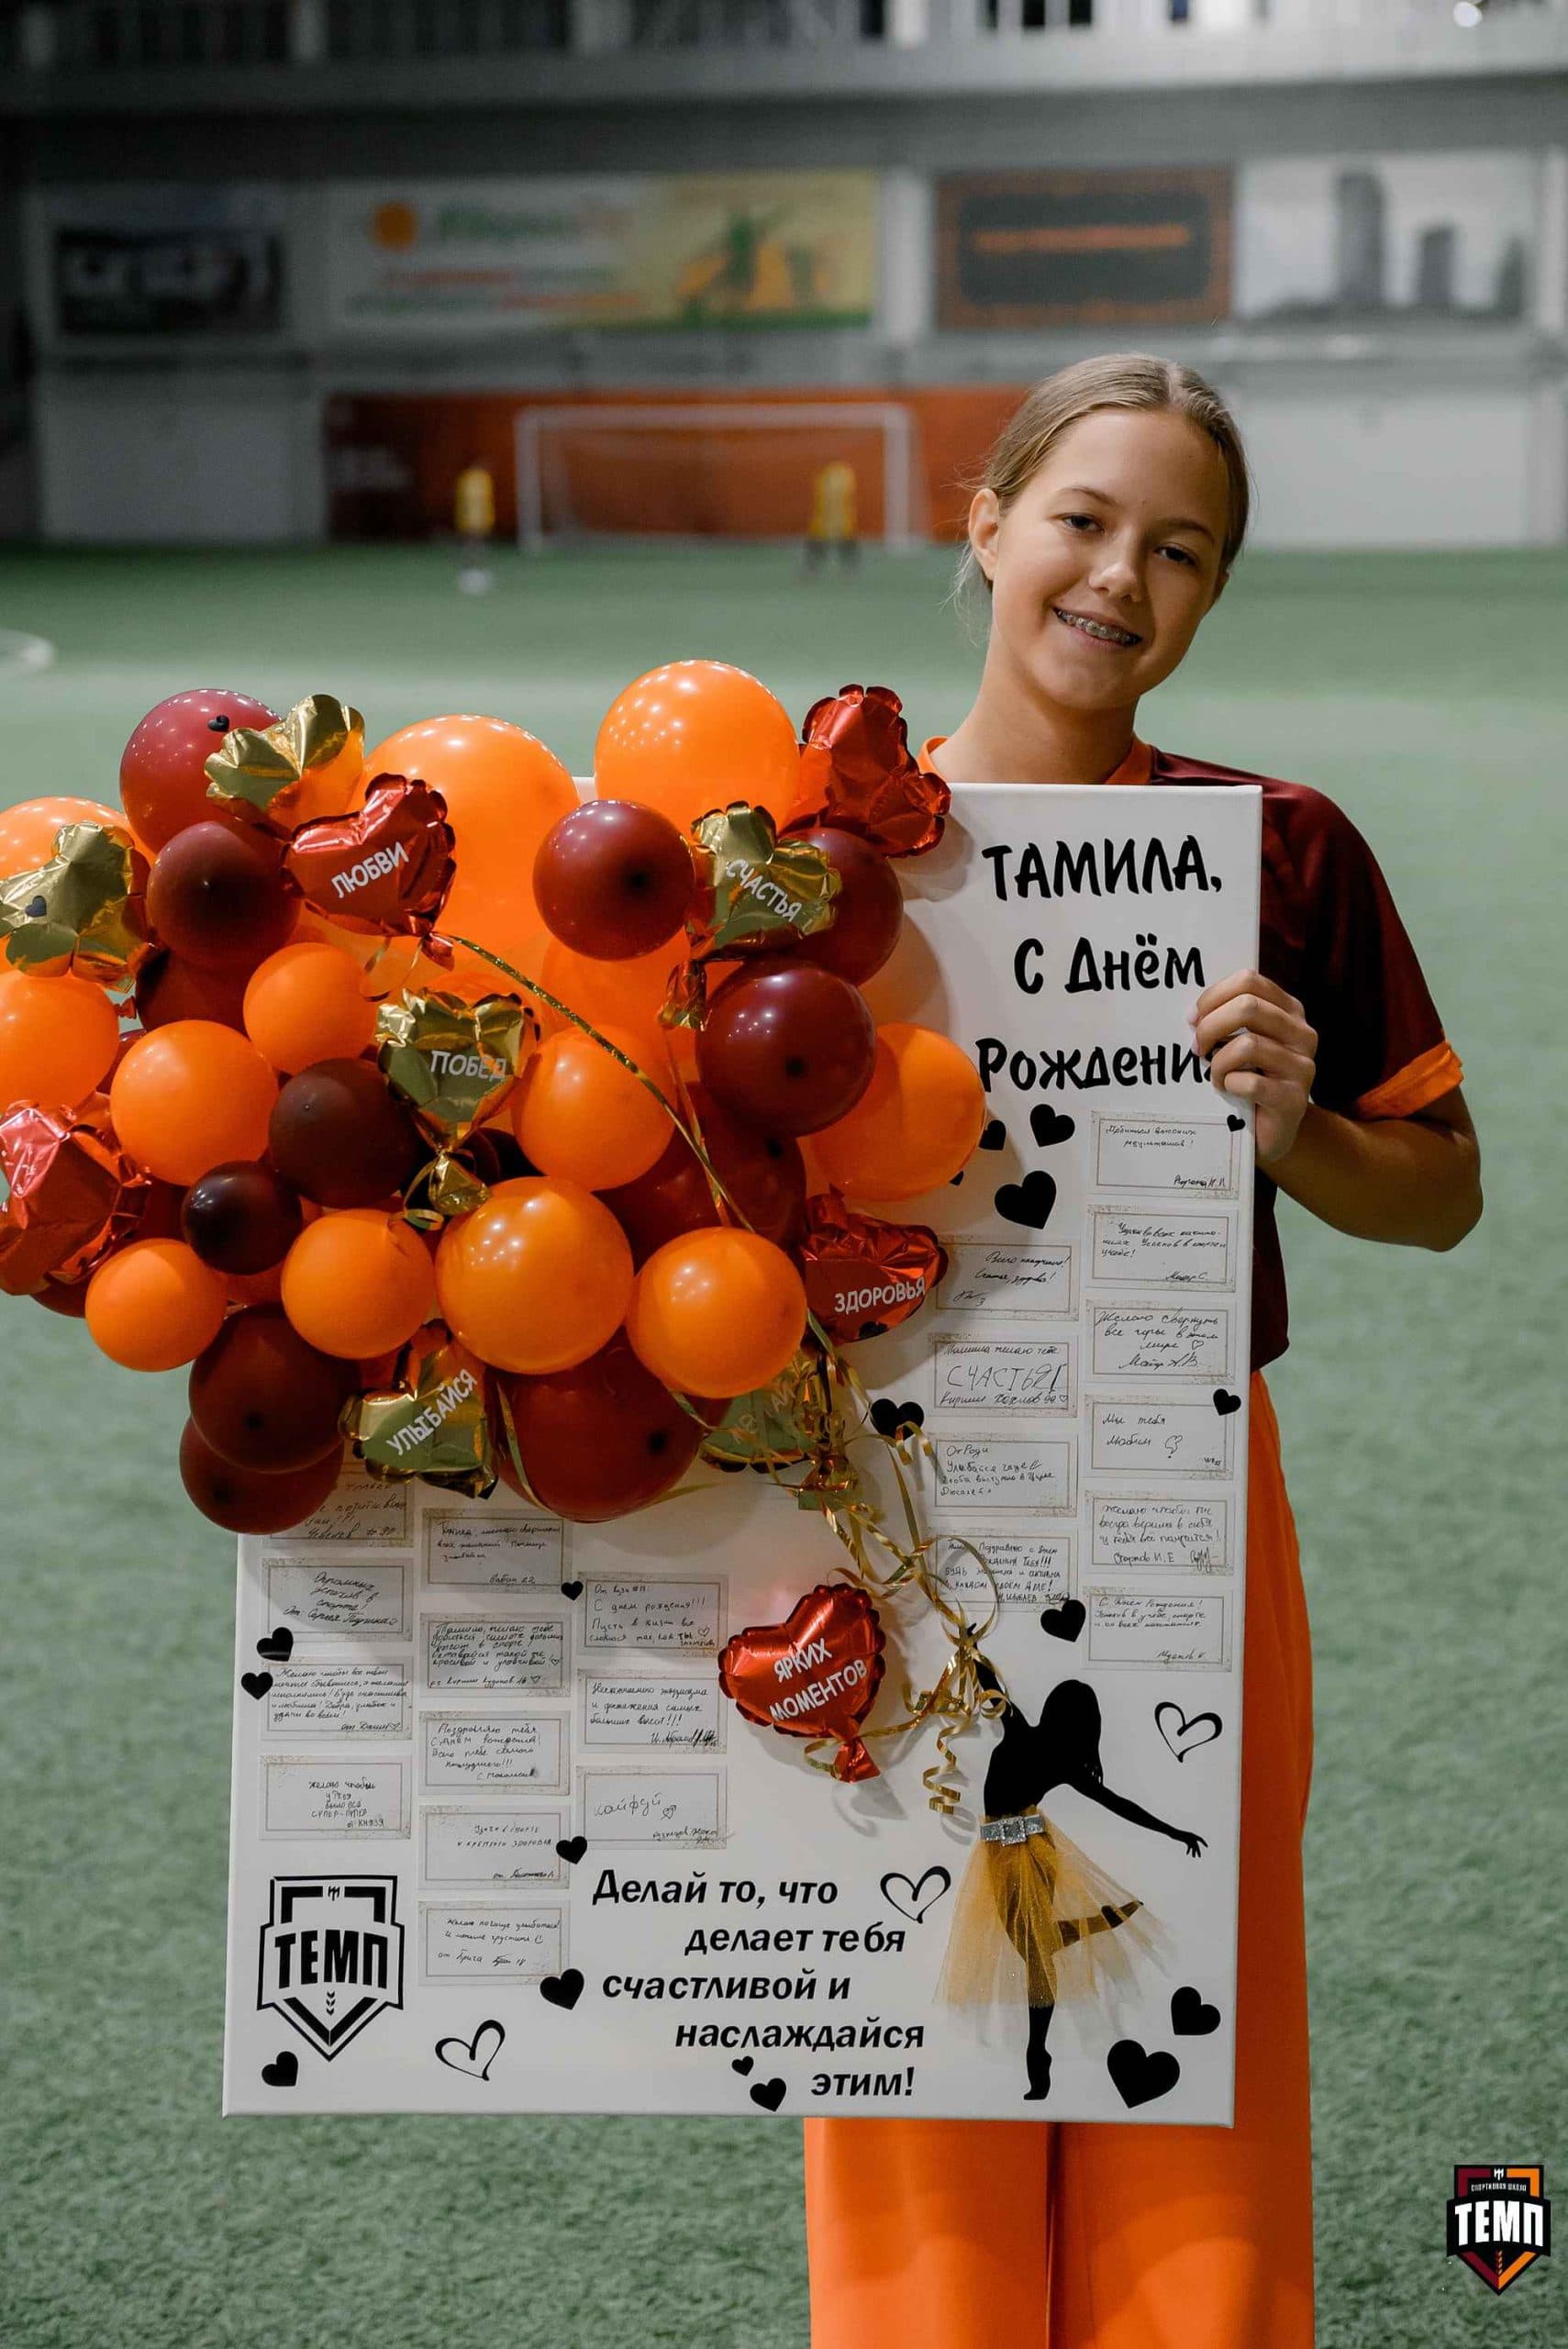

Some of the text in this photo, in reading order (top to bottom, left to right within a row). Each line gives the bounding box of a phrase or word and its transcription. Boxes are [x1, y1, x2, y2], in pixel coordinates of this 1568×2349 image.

[331, 841, 409, 898] ЛЮБВИ
[727, 859, 802, 923] СЧАСТЬЯ
[982, 835, 1222, 901] ТАМИЛА,
[1014, 933, 1205, 994] С Днём
[430, 1051, 506, 1082] ПОБЕД
[974, 1037, 1214, 1092] Рождени
[834, 1276, 926, 1314] ЗДОРОВЬЯ
[386, 1369, 477, 1456] УЛЫБАЙСЯ
[773, 1638, 833, 1682] ЯРКИХ
[769, 1660, 867, 1721] МОМЕНТОВ
[592, 1869, 839, 1909] Делай то, что
[275, 1929, 388, 1989] ТЕМП
[684, 1922, 906, 1955] делает тебя
[602, 1968, 851, 2000] счастливой и
[675, 2017, 924, 2052] наслаждайся
[811, 2066, 915, 2096] этим!
